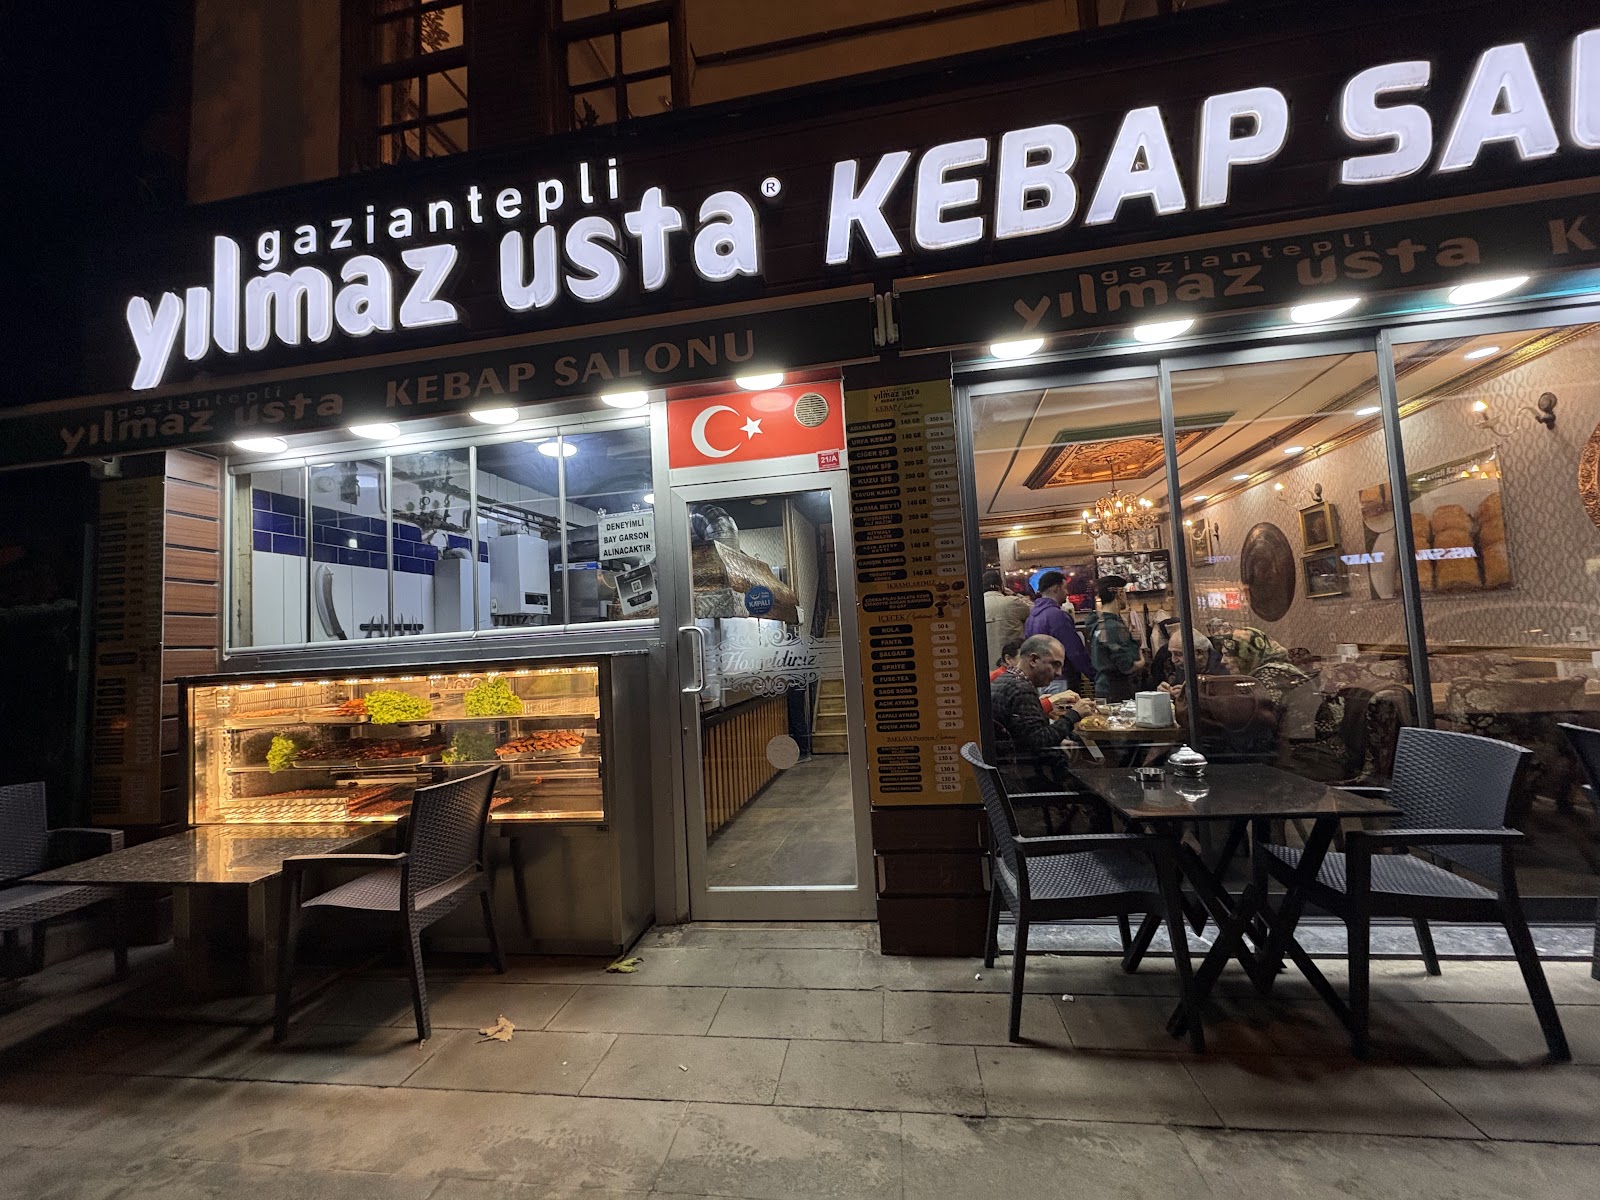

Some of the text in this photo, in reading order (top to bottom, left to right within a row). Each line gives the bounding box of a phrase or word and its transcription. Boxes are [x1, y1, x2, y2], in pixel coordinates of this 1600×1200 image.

[824, 85, 1290, 266] KEBAP
[257, 158, 620, 271] gaziantepli
[1100, 231, 1371, 285] gaziantepli
[125, 233, 460, 392] yılmaz
[500, 185, 762, 312] usta
[1013, 263, 1264, 334] yılmaz
[1296, 235, 1480, 286] usta
[60, 329, 755, 455] yılmaz usta KEBAP SALONU
[901, 389, 920, 397] usta
[117, 385, 281, 421] gaziantepli
[851, 438, 869, 446] URFA
[870, 435, 892, 443] KEBAP
[820, 455, 838, 464] 21/A
[880, 462, 891, 470] ŞİŞ
[857, 477, 879, 485] KUZU
[880, 475, 892, 483] ŞİŞ
[854, 490, 877, 498] TAVUK
[878, 488, 898, 496] KANAT
[855, 505, 877, 513] SARMA
[606, 518, 645, 531] DENEYİMLİ
[604, 531, 649, 544] BAY GARSON
[603, 544, 652, 557] ALINACAKTIR
[748, 599, 770, 608] KAPALI
